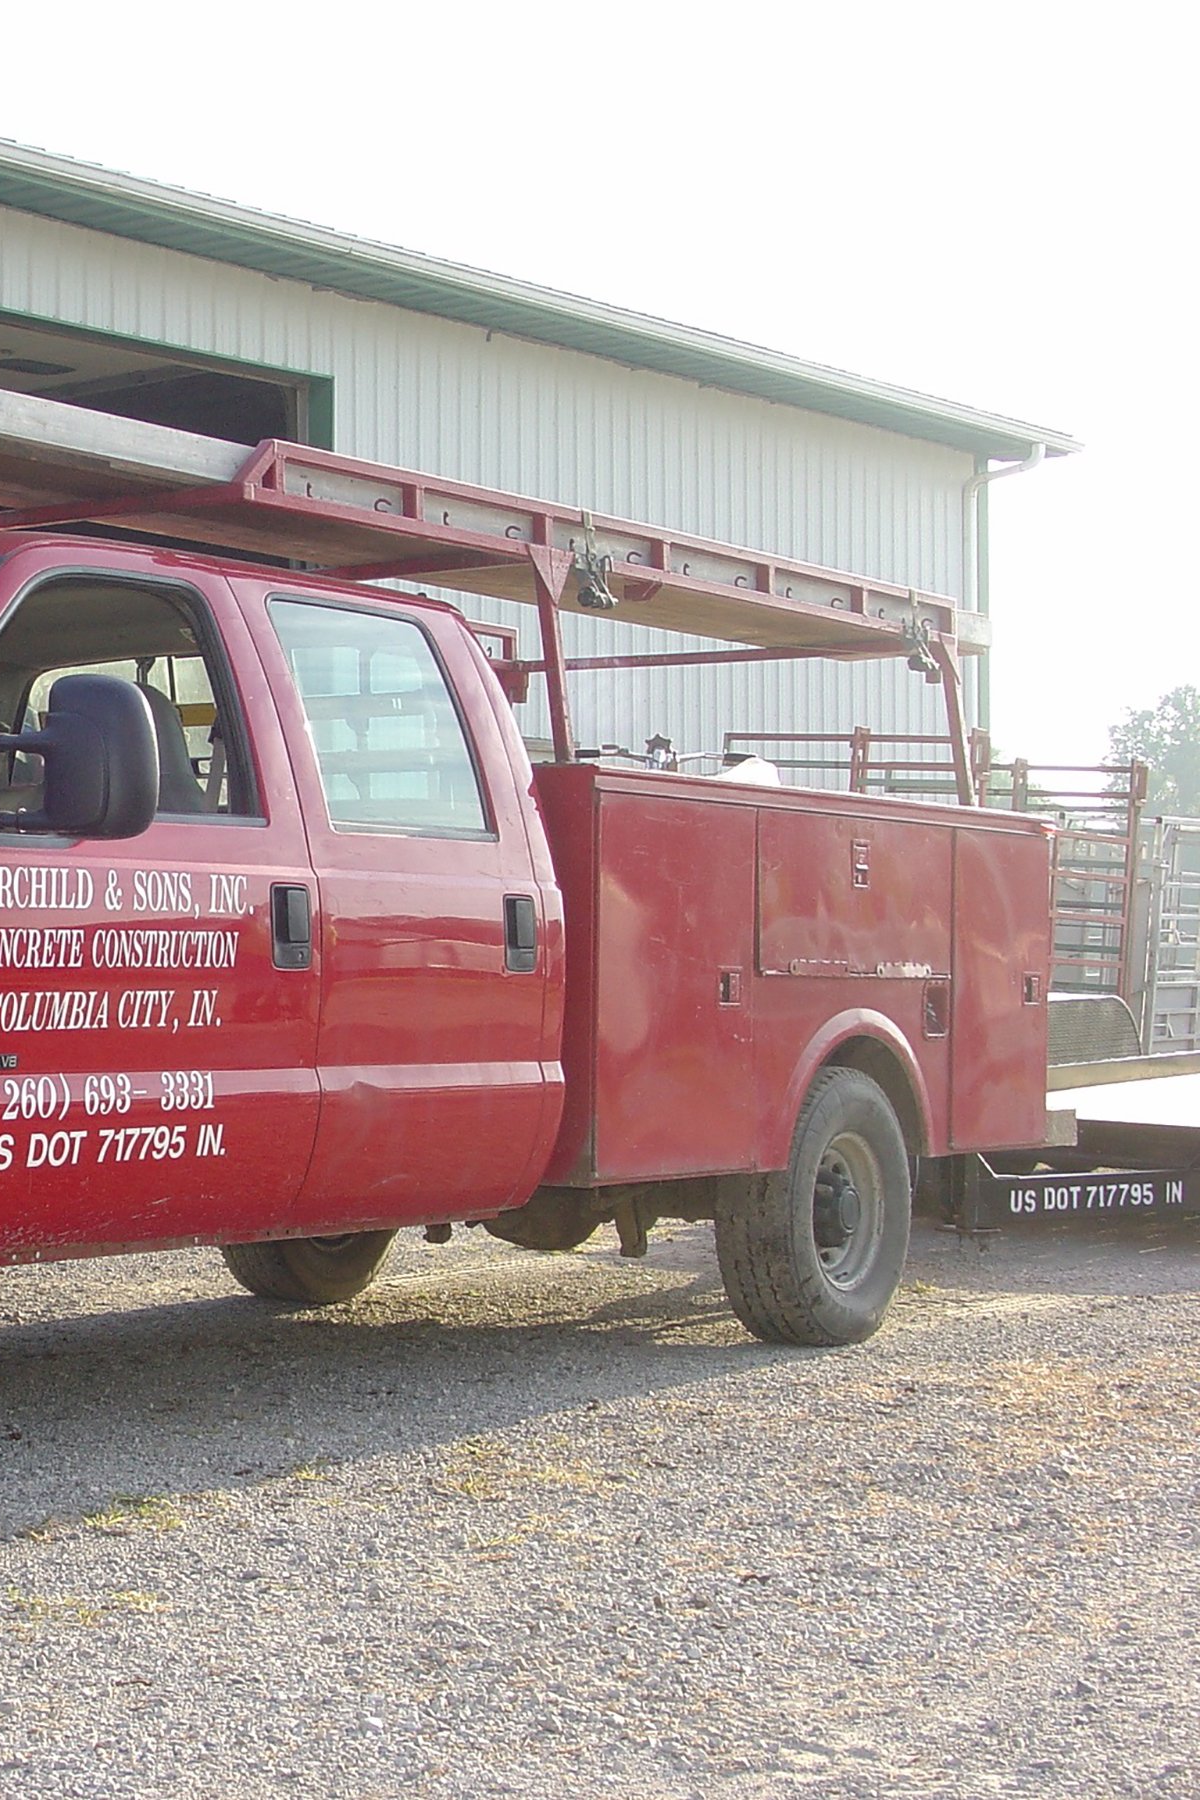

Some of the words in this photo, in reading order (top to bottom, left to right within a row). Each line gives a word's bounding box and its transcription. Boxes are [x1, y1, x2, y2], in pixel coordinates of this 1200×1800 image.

[105, 869, 122, 910] &
[133, 871, 200, 919] SONS,
[209, 874, 254, 915] INC.
[92, 929, 239, 968] CONSTRUCTION
[118, 990, 179, 1034] CITY,
[188, 990, 222, 1027] IN.
[84, 1073, 147, 1116] 693-
[160, 1070, 215, 1111] 3331
[26, 1130, 87, 1168] DOT
[97, 1125, 187, 1163] 717795
[196, 1124, 226, 1157] IN.
[1010, 1190, 1036, 1213] US
[1044, 1186, 1081, 1211] DOT
[1086, 1183, 1153, 1208] 717795
[1166, 1181, 1182, 1203] IN
